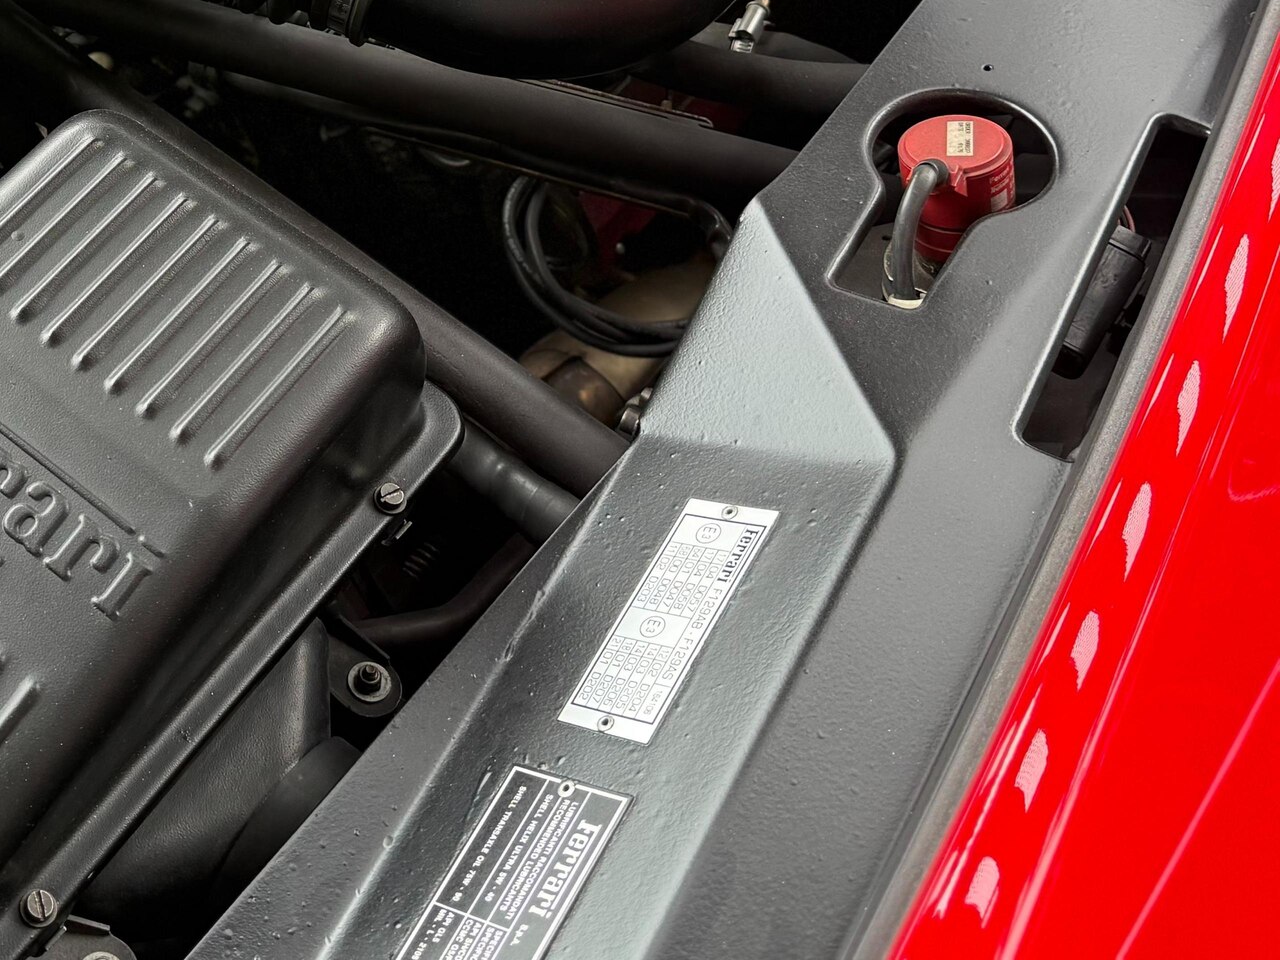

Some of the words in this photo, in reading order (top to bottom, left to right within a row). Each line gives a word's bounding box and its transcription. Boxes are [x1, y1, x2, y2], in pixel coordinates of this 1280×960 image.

[656, 557, 670, 570] 02
[717, 529, 759, 582] Ferrari
[666, 558, 682, 573] 00
[678, 560, 694, 574] 01
[690, 562, 707, 576] 04
[703, 565, 719, 579] 04
[600, 651, 614, 664] 01
[612, 654, 625, 667] 01
[623, 657, 638, 671] 03
[635, 659, 650, 674] 03
[648, 662, 662, 677] 02
[578, 671, 602, 700] D202
[589, 674, 613, 703] D207
[603, 677, 626, 706] D206
[615, 680, 638, 709] D205
[626, 683, 650, 712] D204
[508, 786, 527, 808] SHELL
[534, 794, 554, 818] SHELL
[481, 811, 512, 854] TRANSAXLE
[519, 820, 538, 843] HELIX
[530, 799, 570, 859] RECOMMENDED
[543, 801, 579, 855] LUBRIFICANTI
[472, 855, 484, 867] OIL
[503, 845, 523, 870] ULTRA
[462, 870, 476, 886] 75W
[528, 819, 602, 919] Ferrari
[499, 861, 534, 911] LUBRICANTS
[504, 856, 547, 920] RACCOMANDATI
[484, 892, 495, 902] 40
[434, 909, 447, 922] MIL
[442, 912, 454, 926] API
[469, 922, 482, 936] API
